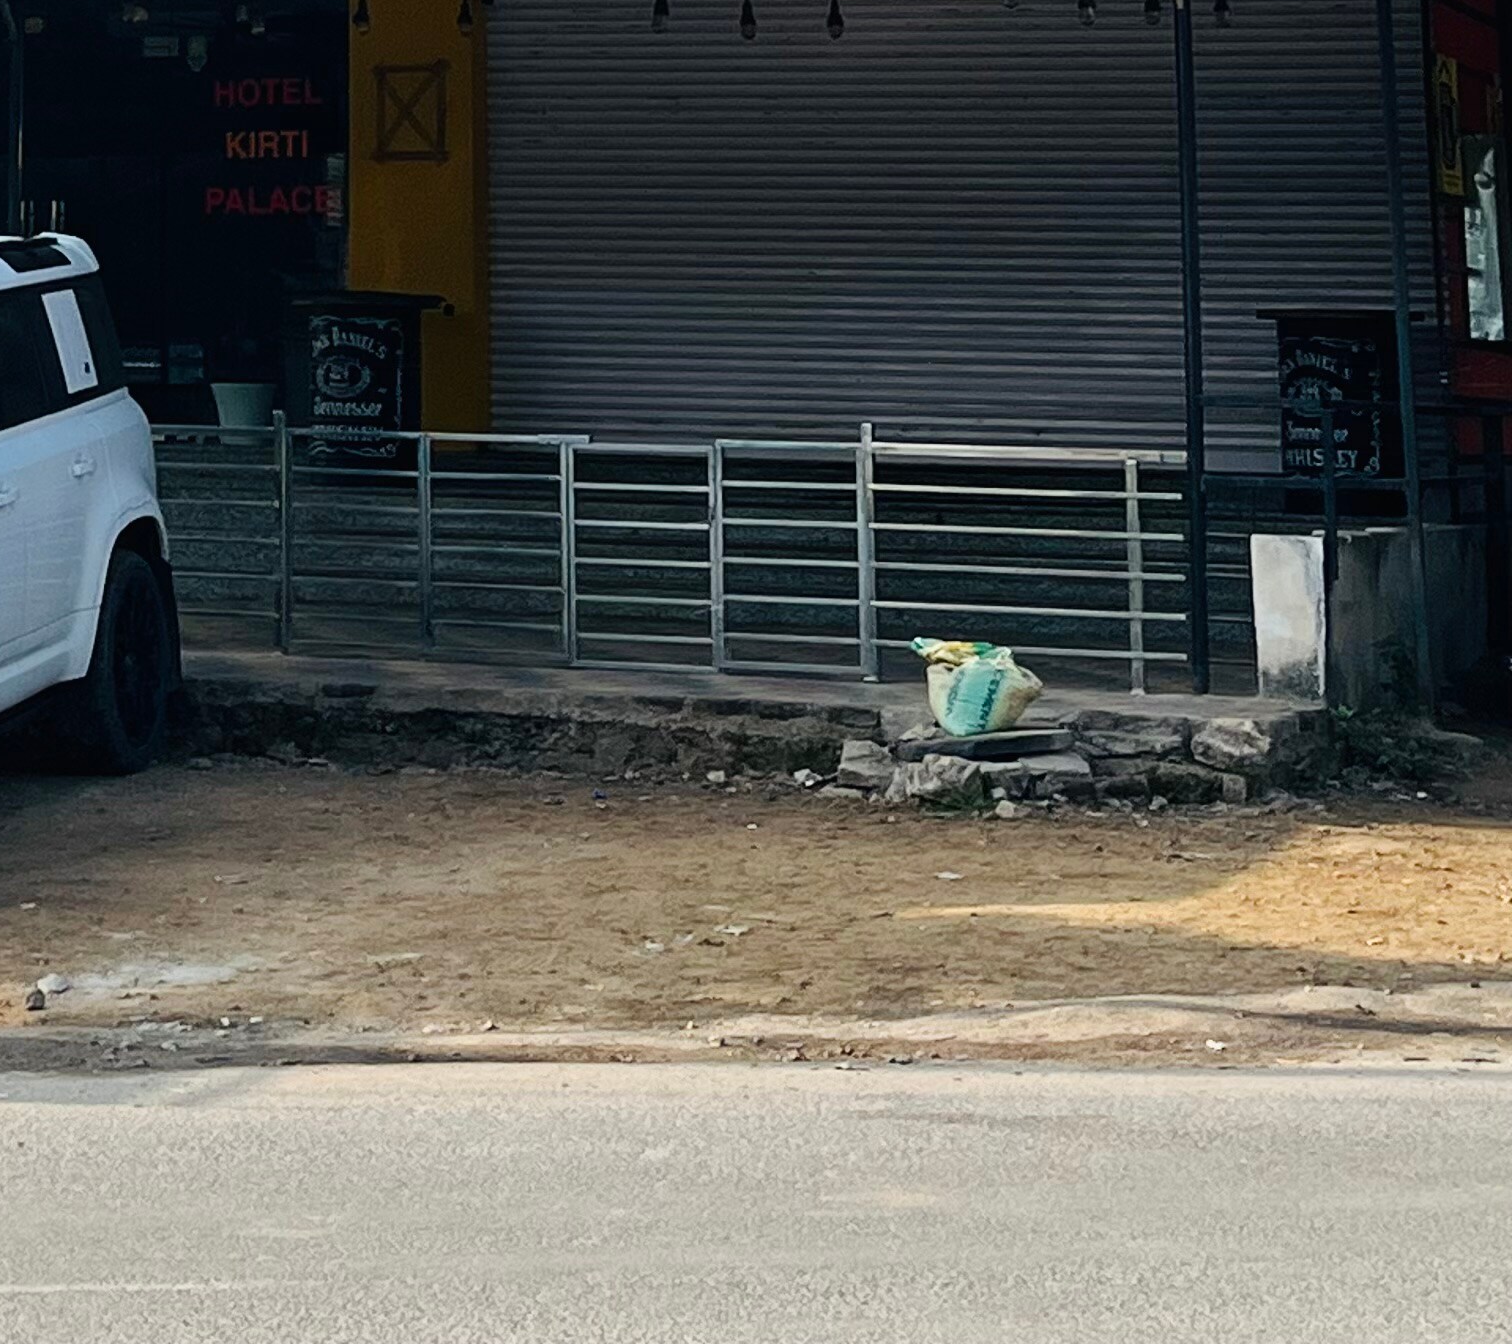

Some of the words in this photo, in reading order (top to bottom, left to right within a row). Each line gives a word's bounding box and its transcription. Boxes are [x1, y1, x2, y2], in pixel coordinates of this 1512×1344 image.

[214, 78, 322, 108] HOTEL
[225, 129, 309, 160] KIRTI
[204, 184, 342, 214] PALACE
